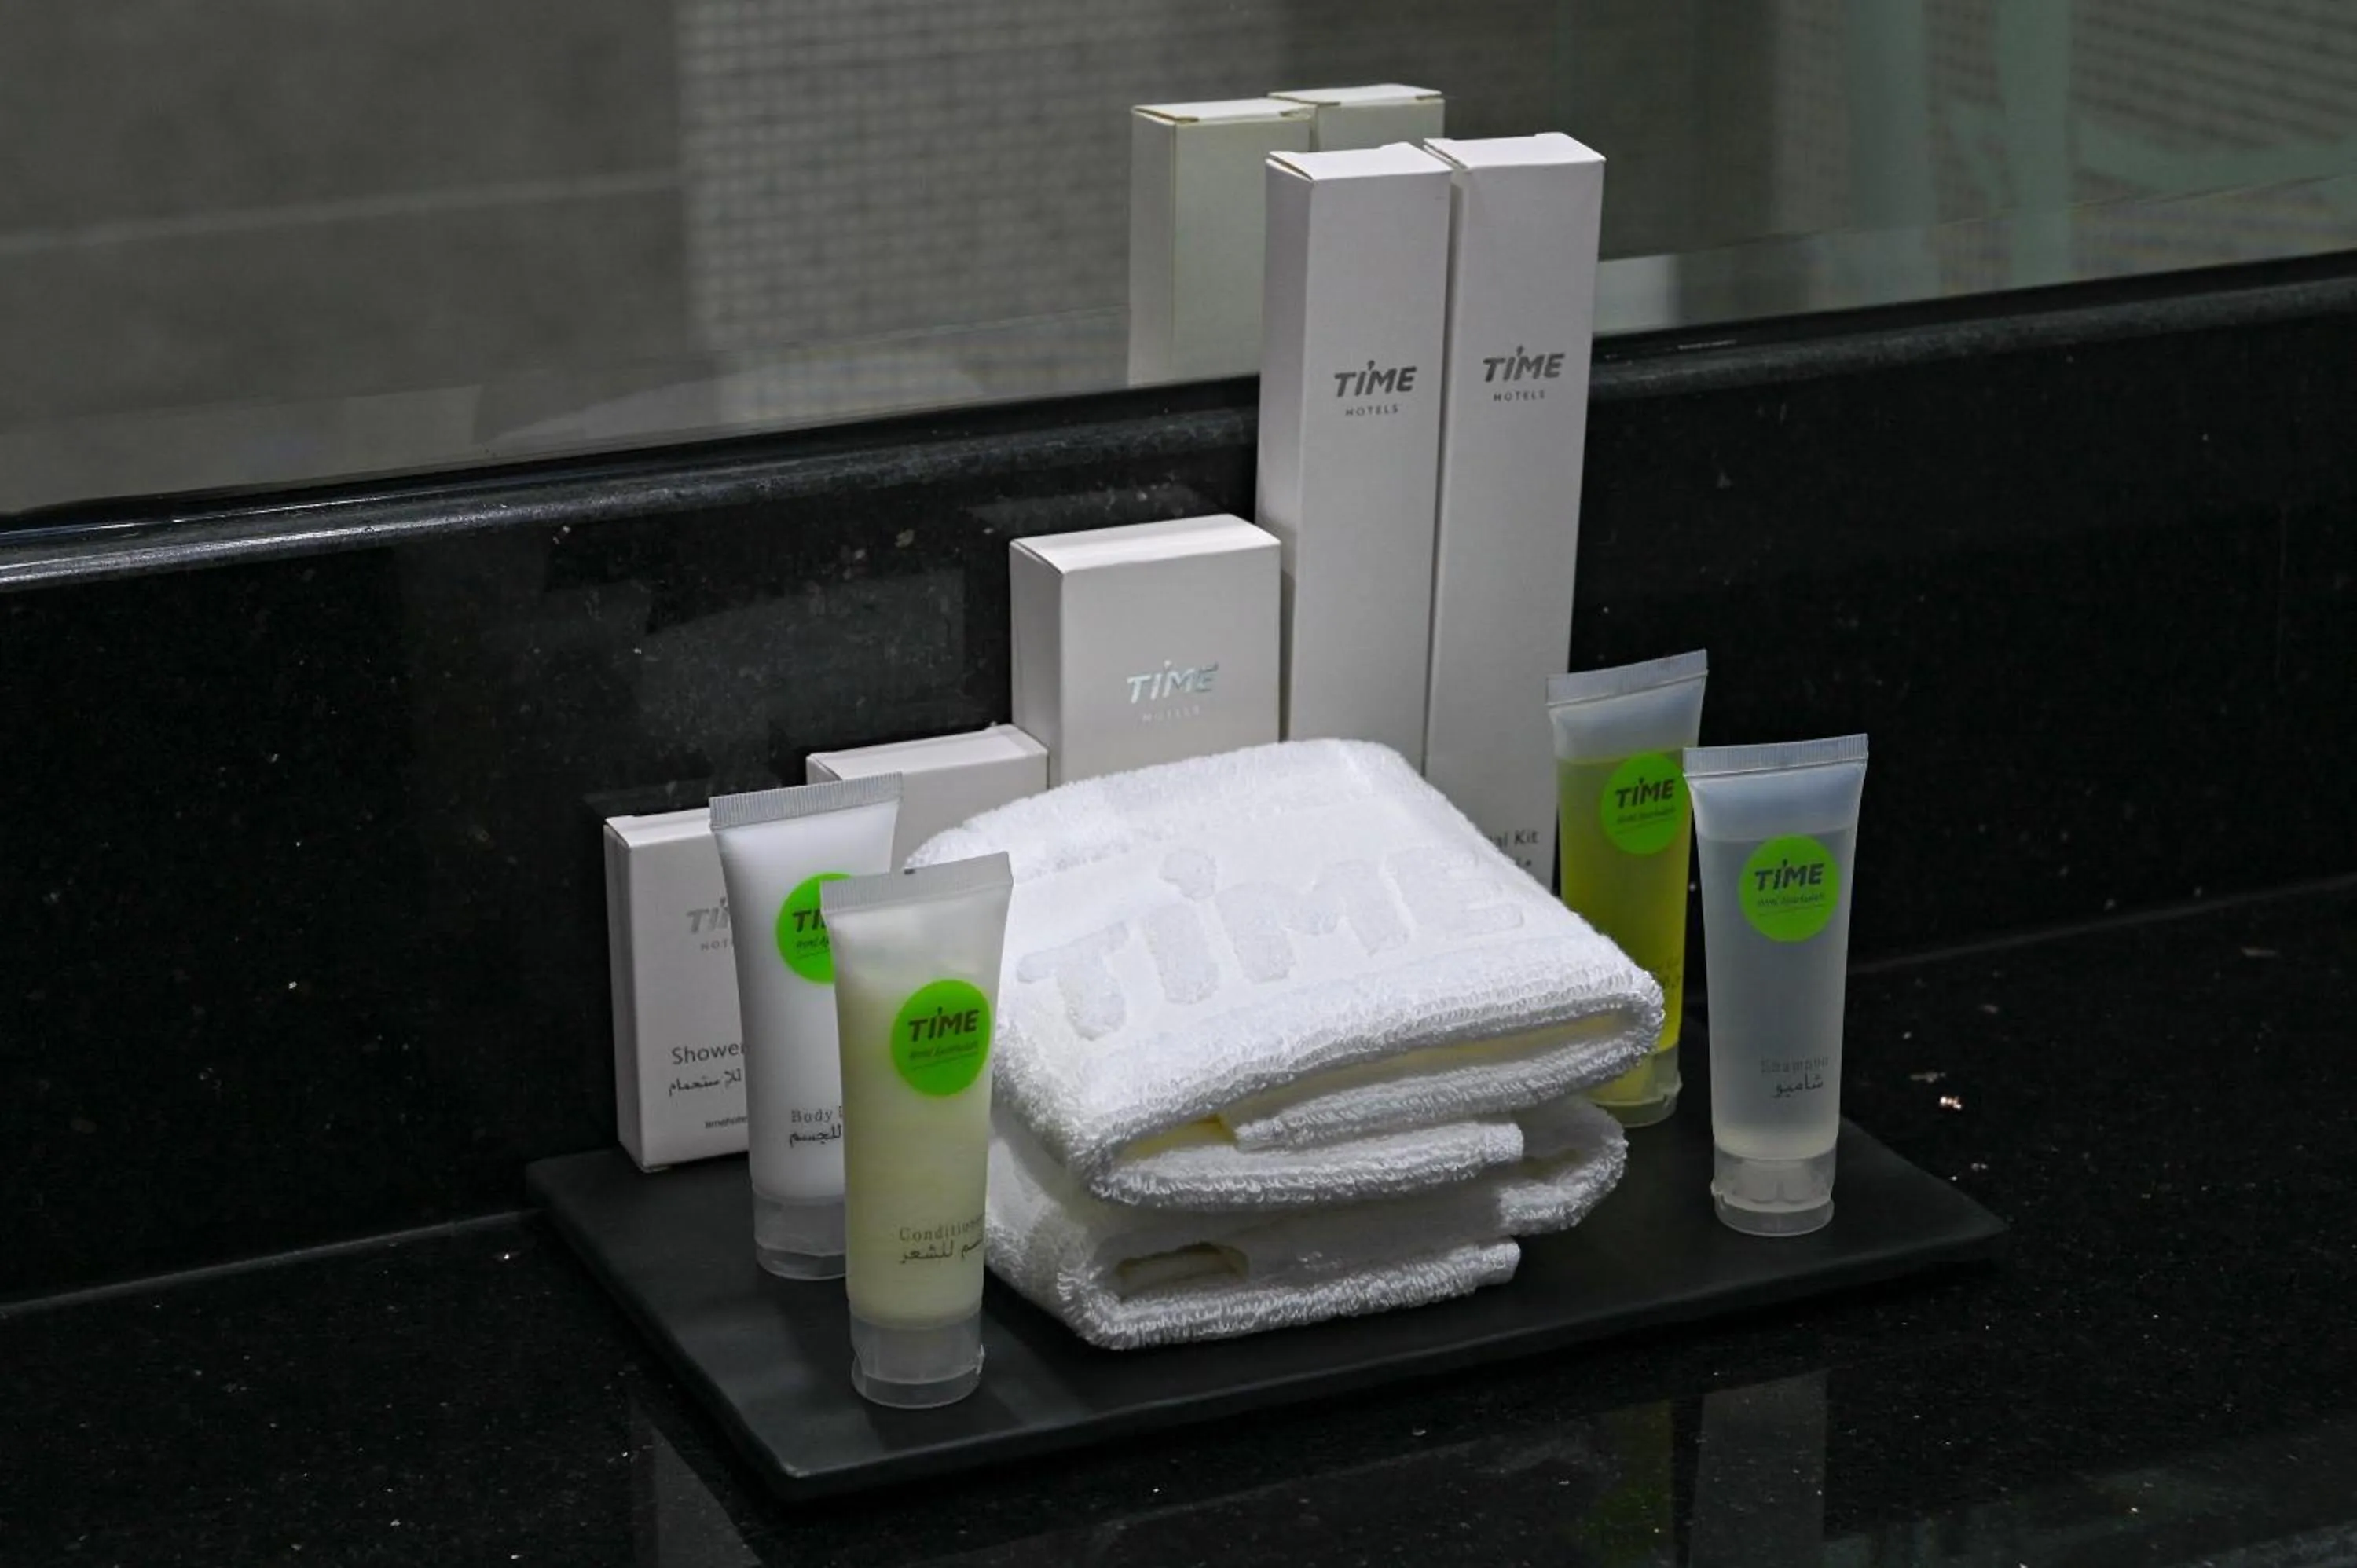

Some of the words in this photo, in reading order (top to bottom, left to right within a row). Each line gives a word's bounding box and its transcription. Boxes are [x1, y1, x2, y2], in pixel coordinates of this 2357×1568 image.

[1334, 359, 1417, 397] TIME
[1483, 344, 1565, 383] TIME
[1345, 403, 1398, 416] HOTELS
[1494, 390, 1545, 402] HOTELS
[1126, 660, 1219, 704] TIME
[1615, 776, 1674, 808] TIME
[1754, 858, 1824, 892] TIME
[1016, 846, 1523, 1041] TIME
[907, 1006, 980, 1042] TIME
[791, 1108, 833, 1123] Body
